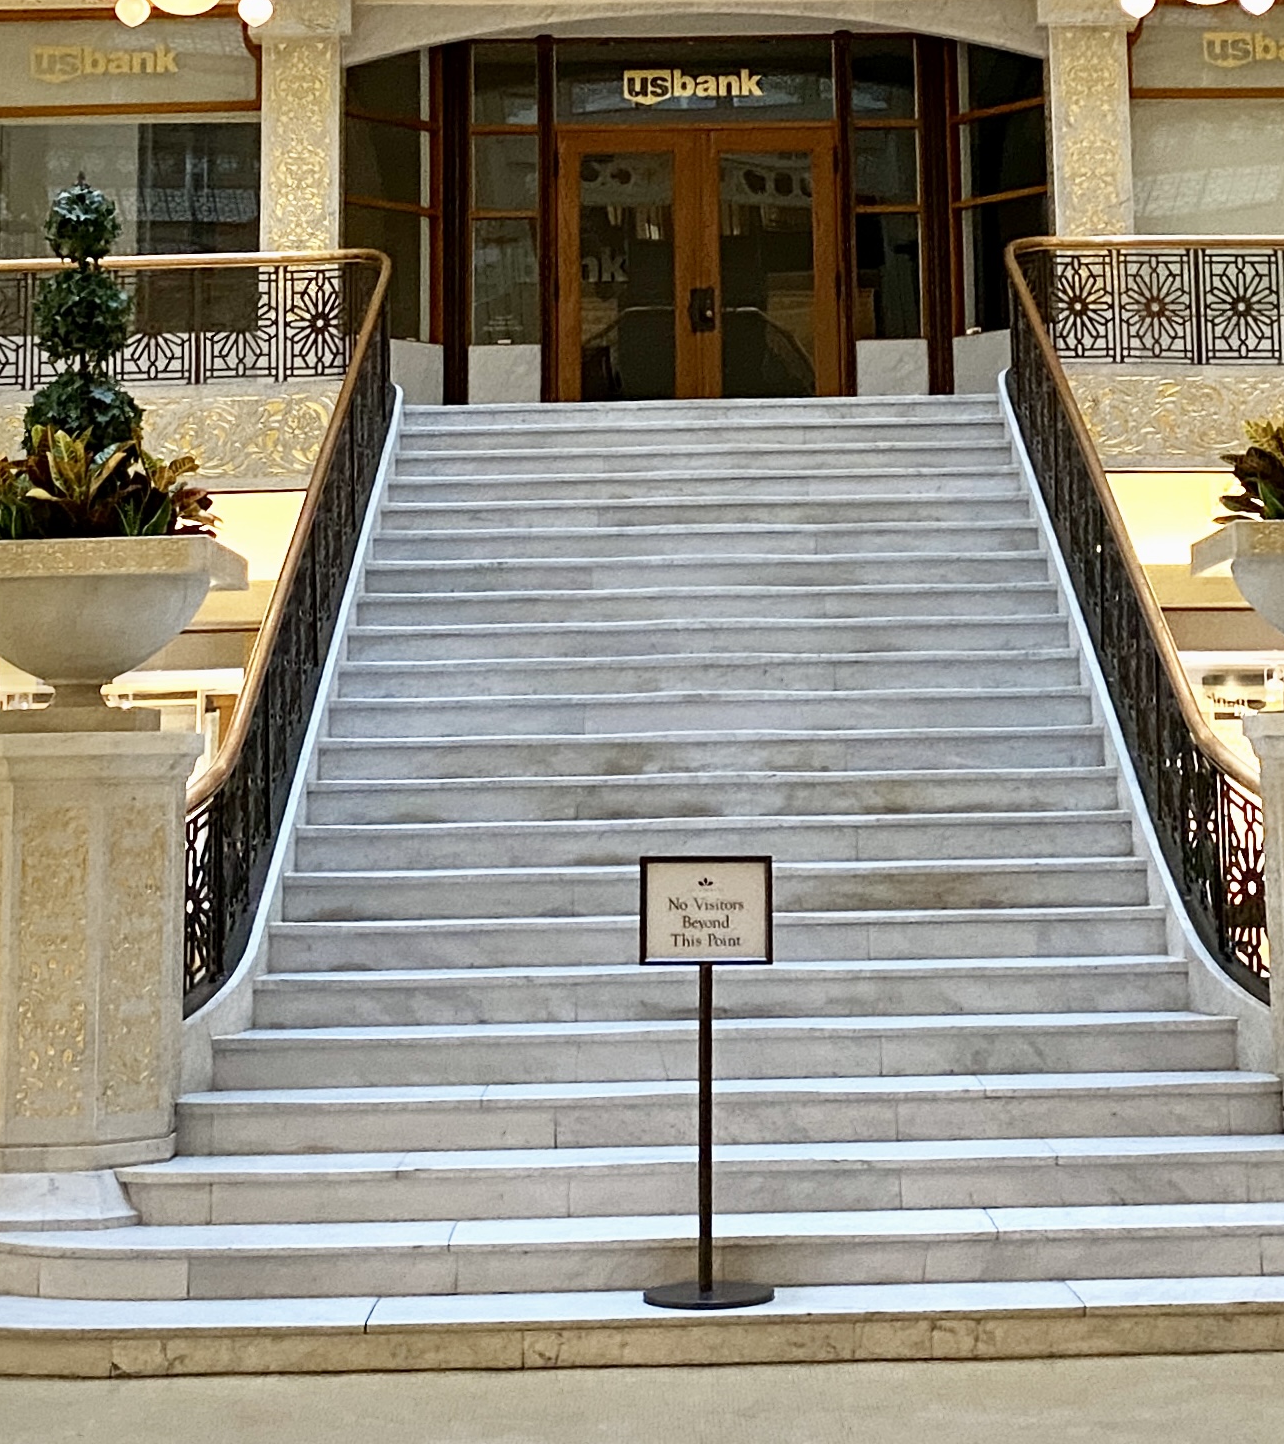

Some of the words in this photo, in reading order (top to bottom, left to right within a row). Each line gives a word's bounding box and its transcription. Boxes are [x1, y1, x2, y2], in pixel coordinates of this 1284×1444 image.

[30, 44, 179, 83] usbank
[623, 68, 764, 105] usbank
[668, 897, 688, 911] No
[694, 897, 744, 911] Visitors
[683, 915, 730, 931] Beyond
[671, 933, 702, 947] This
[708, 933, 741, 947] Point
